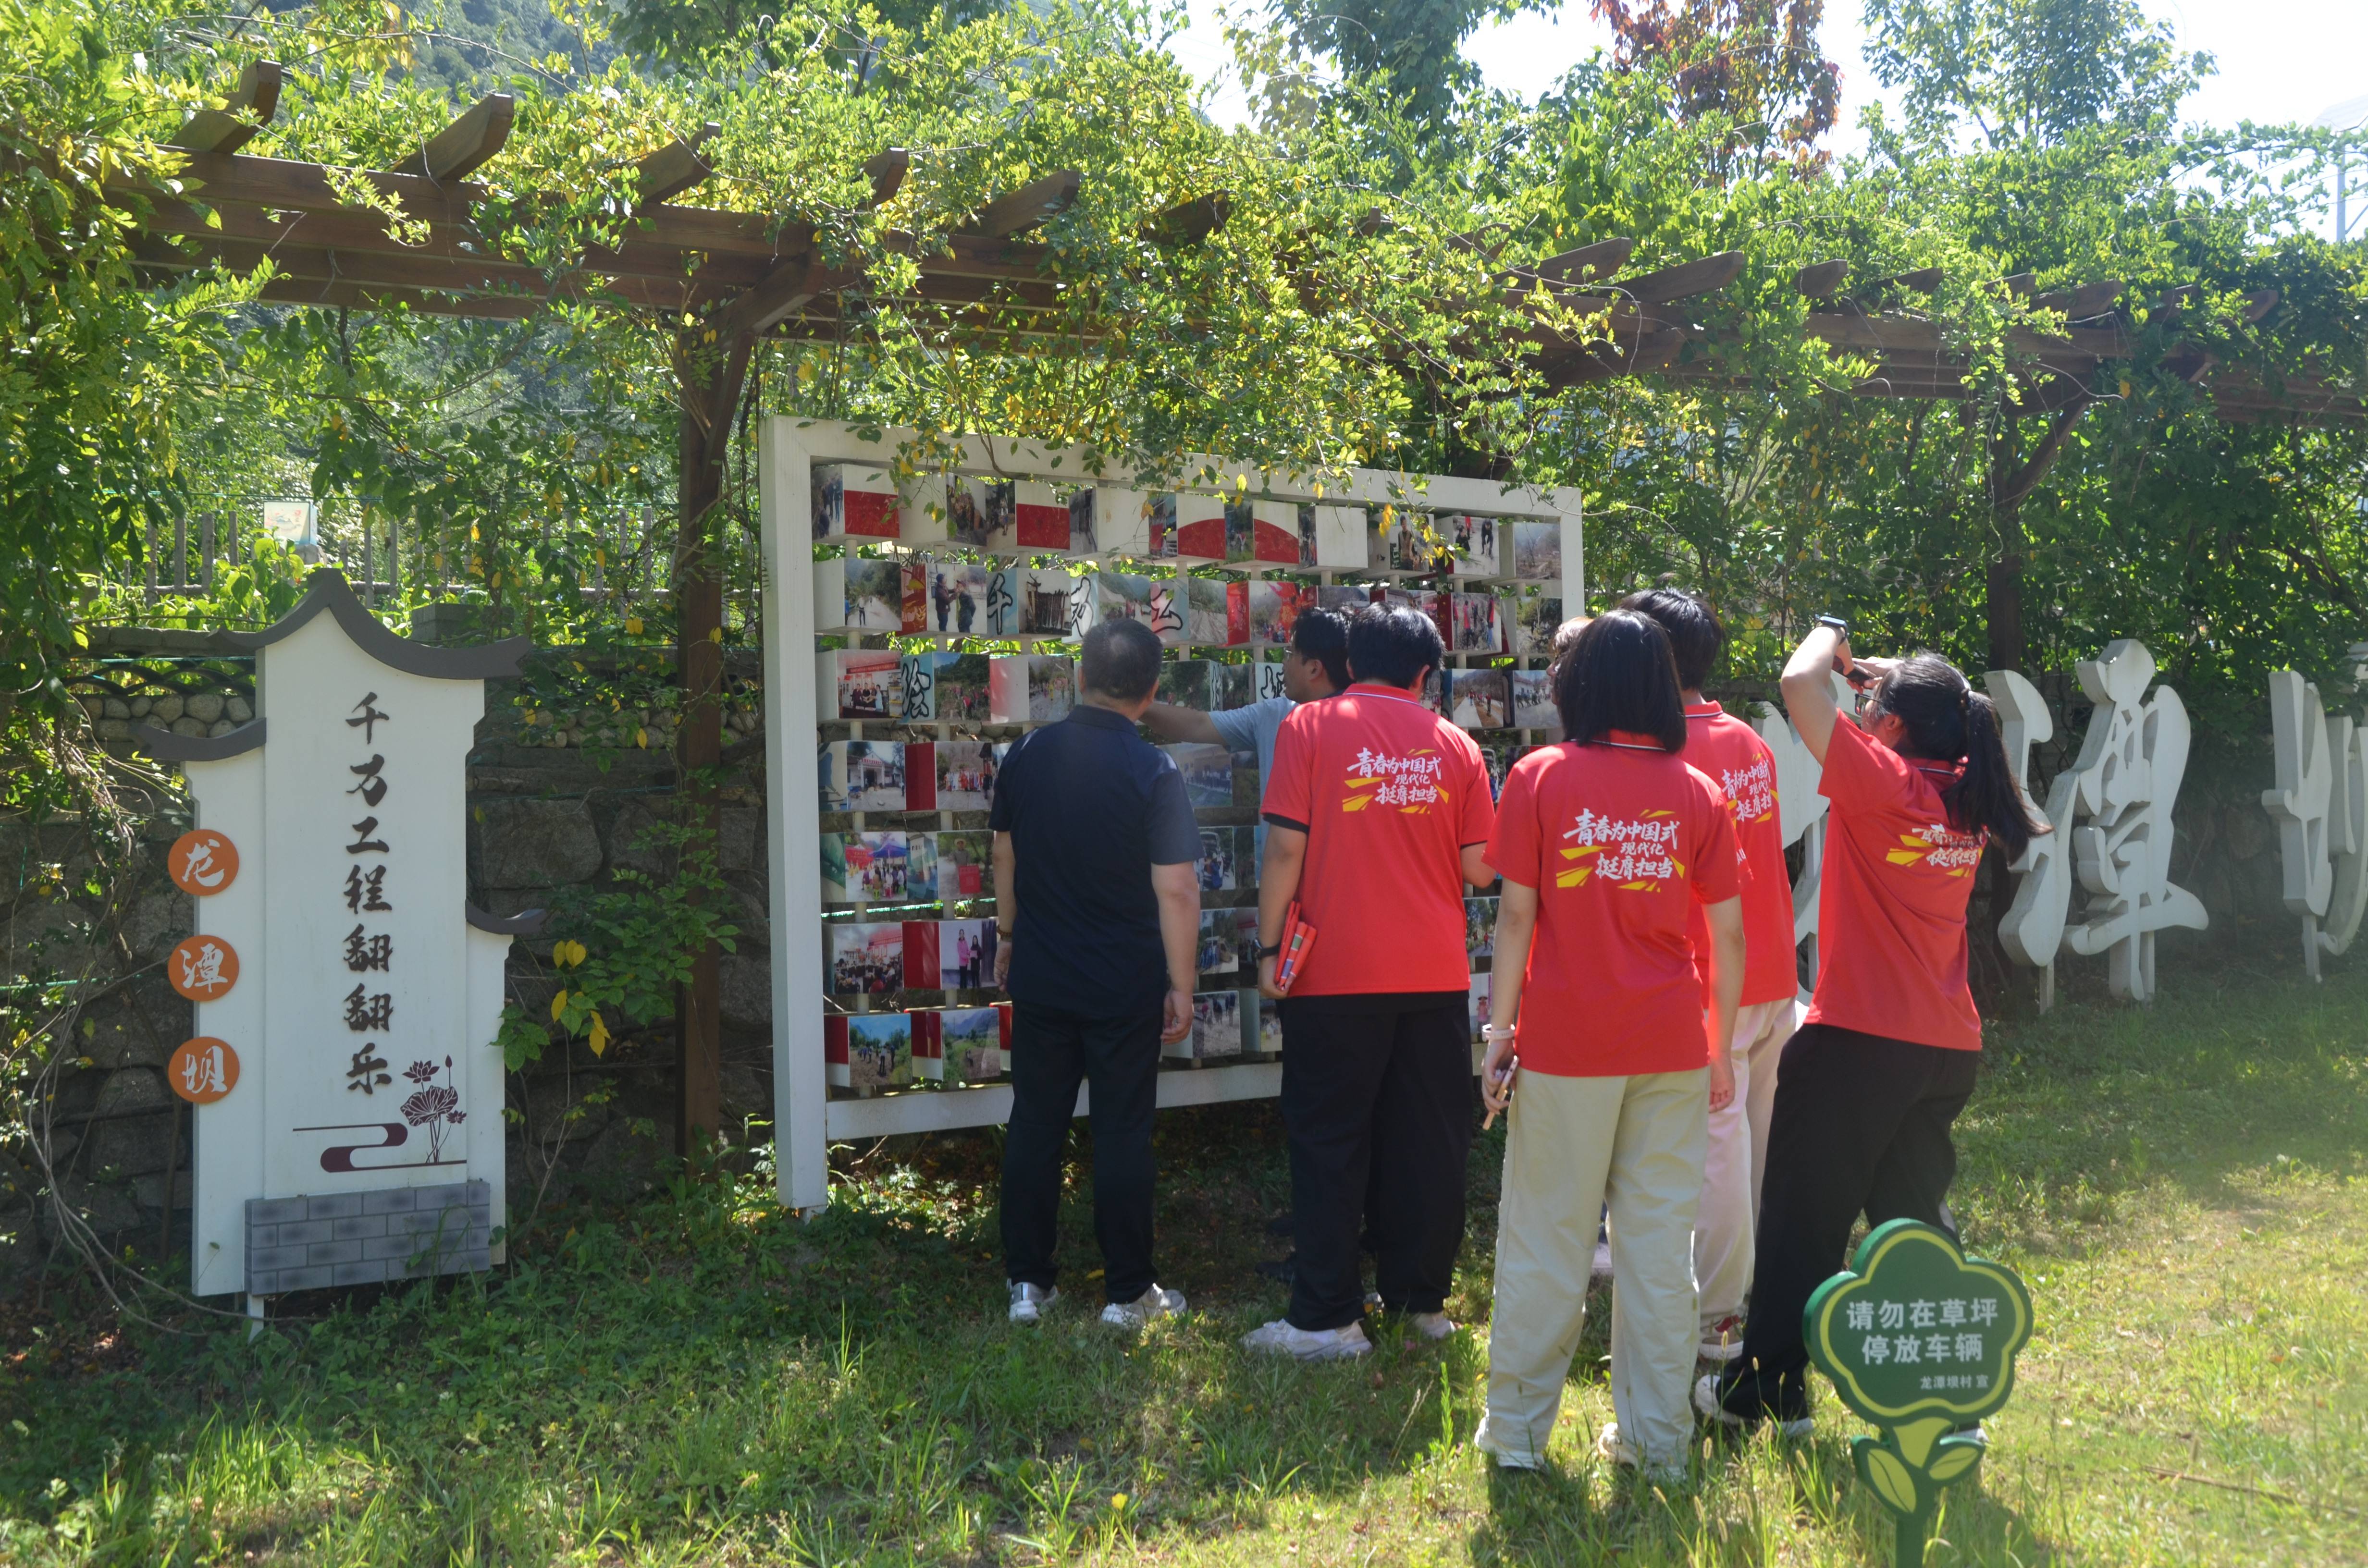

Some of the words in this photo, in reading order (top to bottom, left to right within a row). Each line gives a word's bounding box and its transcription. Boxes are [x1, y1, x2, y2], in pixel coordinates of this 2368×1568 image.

[1347, 747, 1442, 780] 青春为中国式
[1375, 782, 1438, 805] 挺膺担当
[1395, 773, 1430, 786] 现代化
[1563, 808, 1680, 850] 青春为中国式
[1620, 842, 1665, 858] 现代化
[1595, 852, 1673, 880] 挺膺担当
[343, 692, 394, 1095] 千万工程翻翻乐
[1847, 1298, 1998, 1331] 请勿在草坪
[1862, 1333, 1983, 1365] 停放车辆
[1920, 1375, 1973, 1390] 龙潭坝村
[1976, 1374, 1989, 1388] 宣
